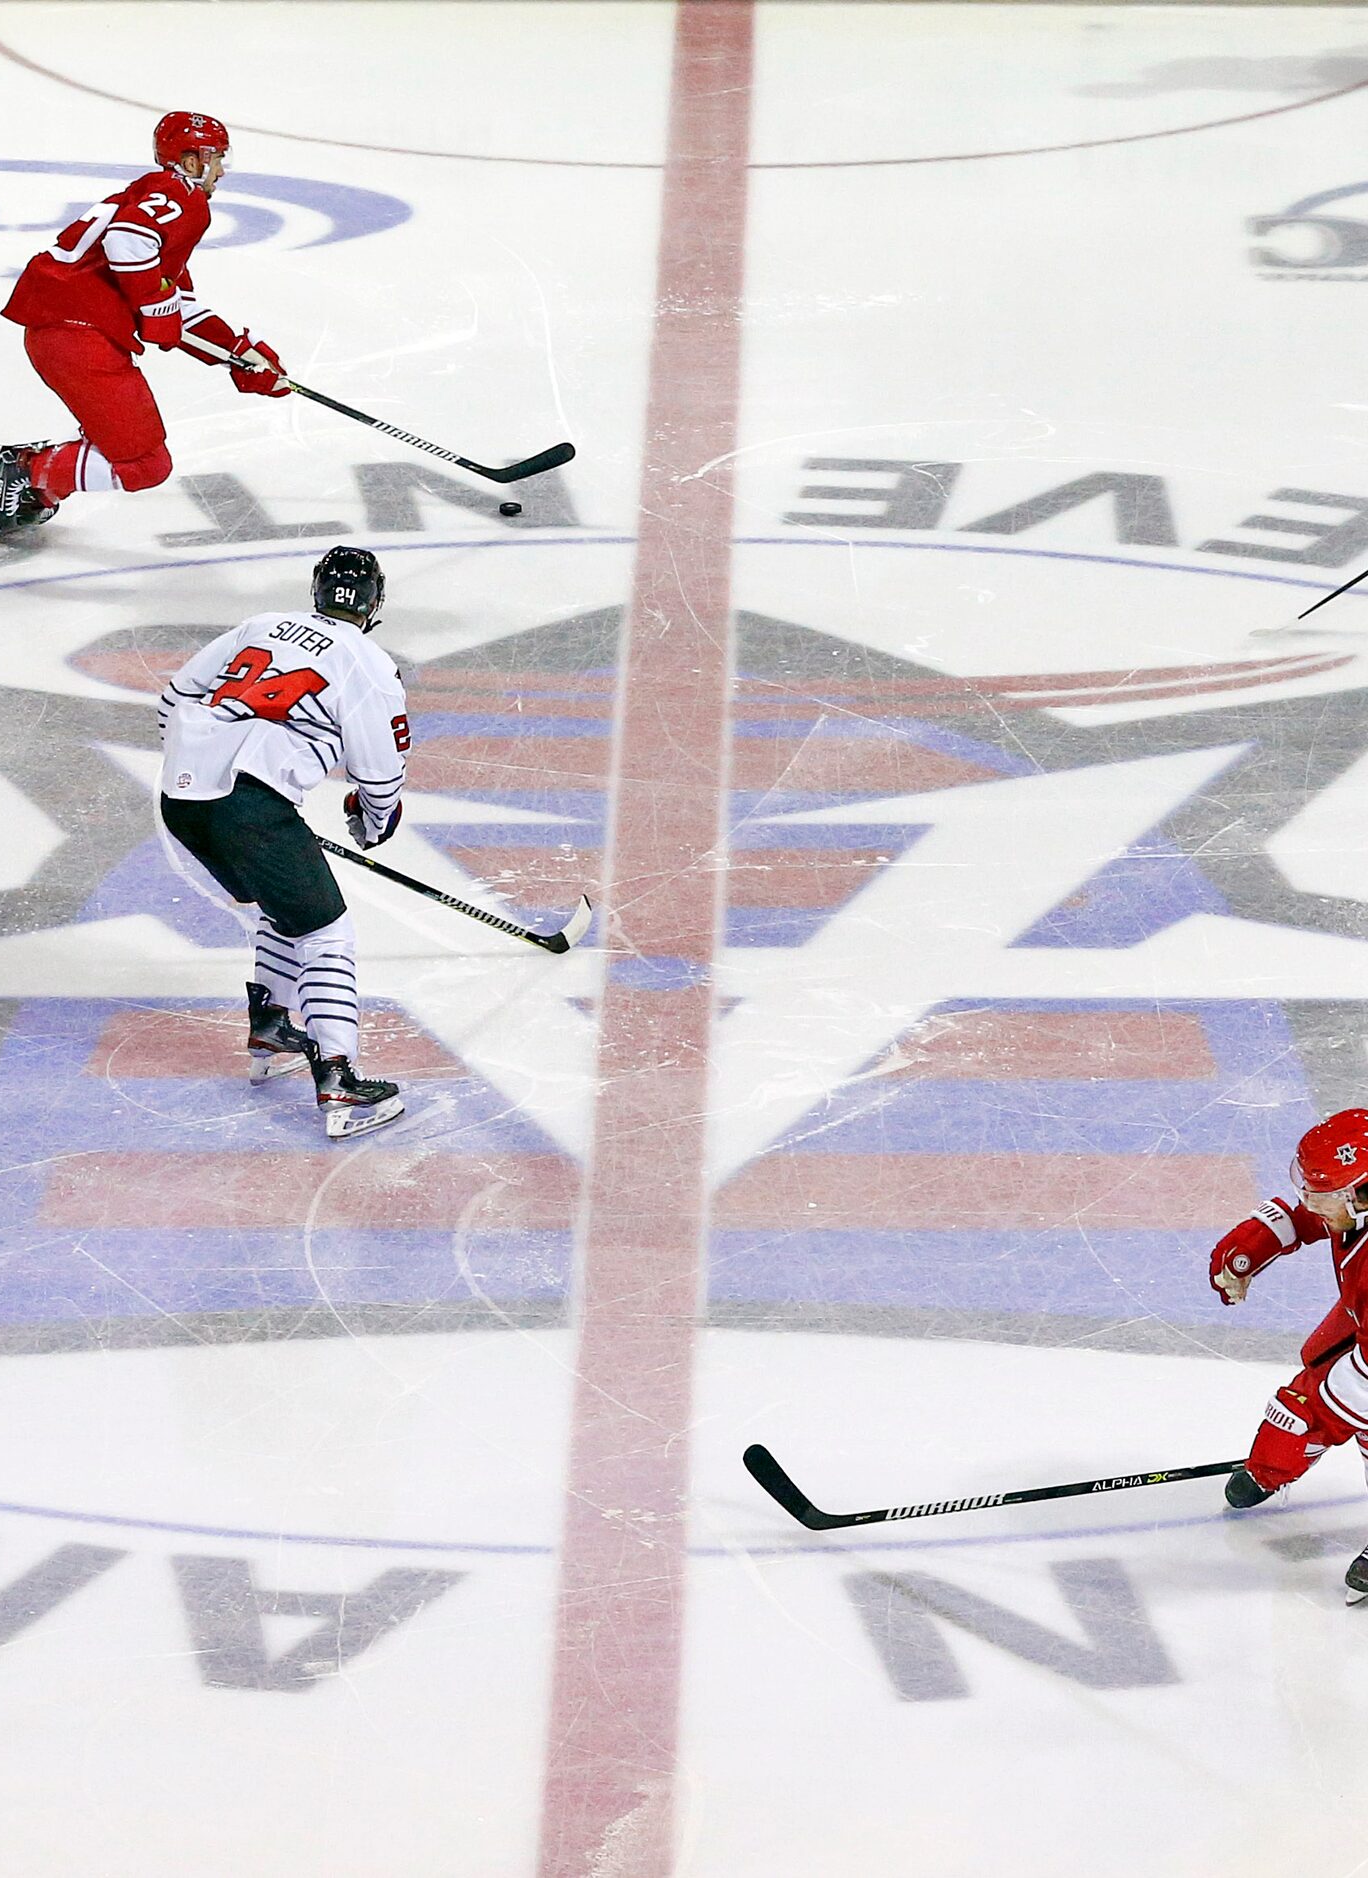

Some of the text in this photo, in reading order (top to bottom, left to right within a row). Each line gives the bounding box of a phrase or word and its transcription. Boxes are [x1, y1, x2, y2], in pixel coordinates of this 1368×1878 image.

[137, 192, 183, 225] 27
[372, 419, 460, 463] WARRIOR
[334, 586, 356, 606] 24
[268, 620, 334, 657] SUTER
[208, 645, 330, 721] 24
[1091, 1475, 1143, 1492] ALPHA
[1147, 1472, 1169, 1485] DX
[885, 1493, 1007, 1521] WARRIOR
